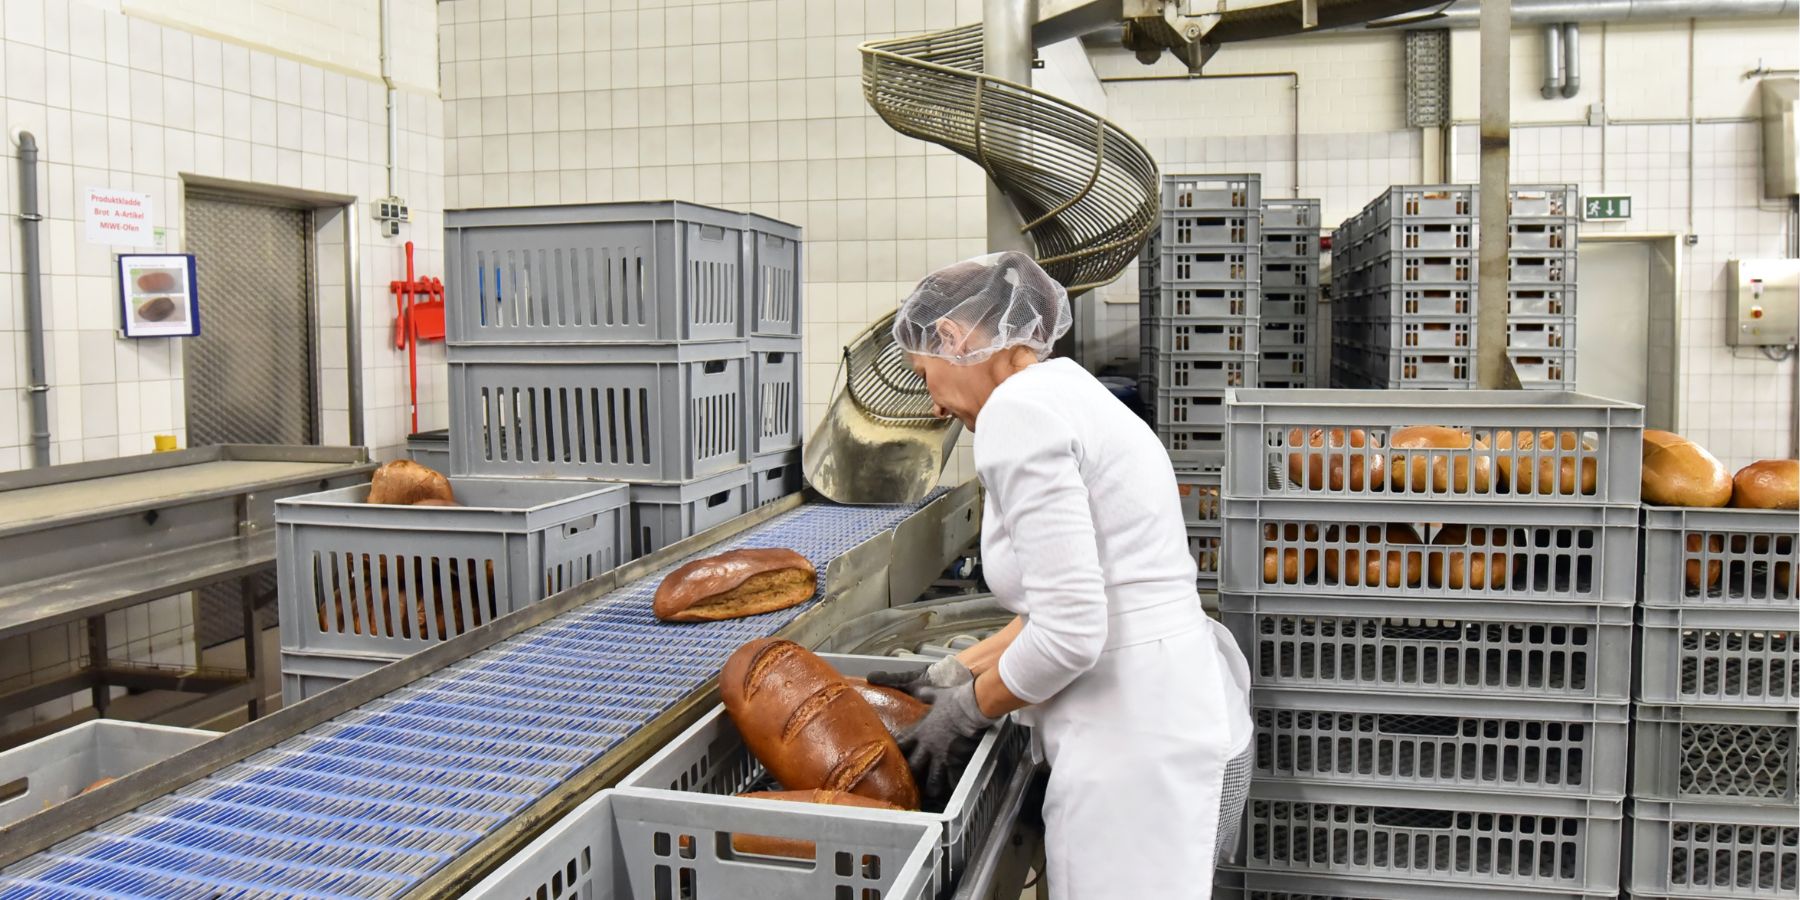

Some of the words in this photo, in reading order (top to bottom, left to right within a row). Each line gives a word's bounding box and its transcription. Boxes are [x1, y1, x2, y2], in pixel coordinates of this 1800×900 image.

[91, 194, 141, 206] Produktkladde
[94, 208, 109, 216] Brot
[115, 210, 145, 219] A-Artikel
[100, 222, 139, 231] MIWE-Ofen
